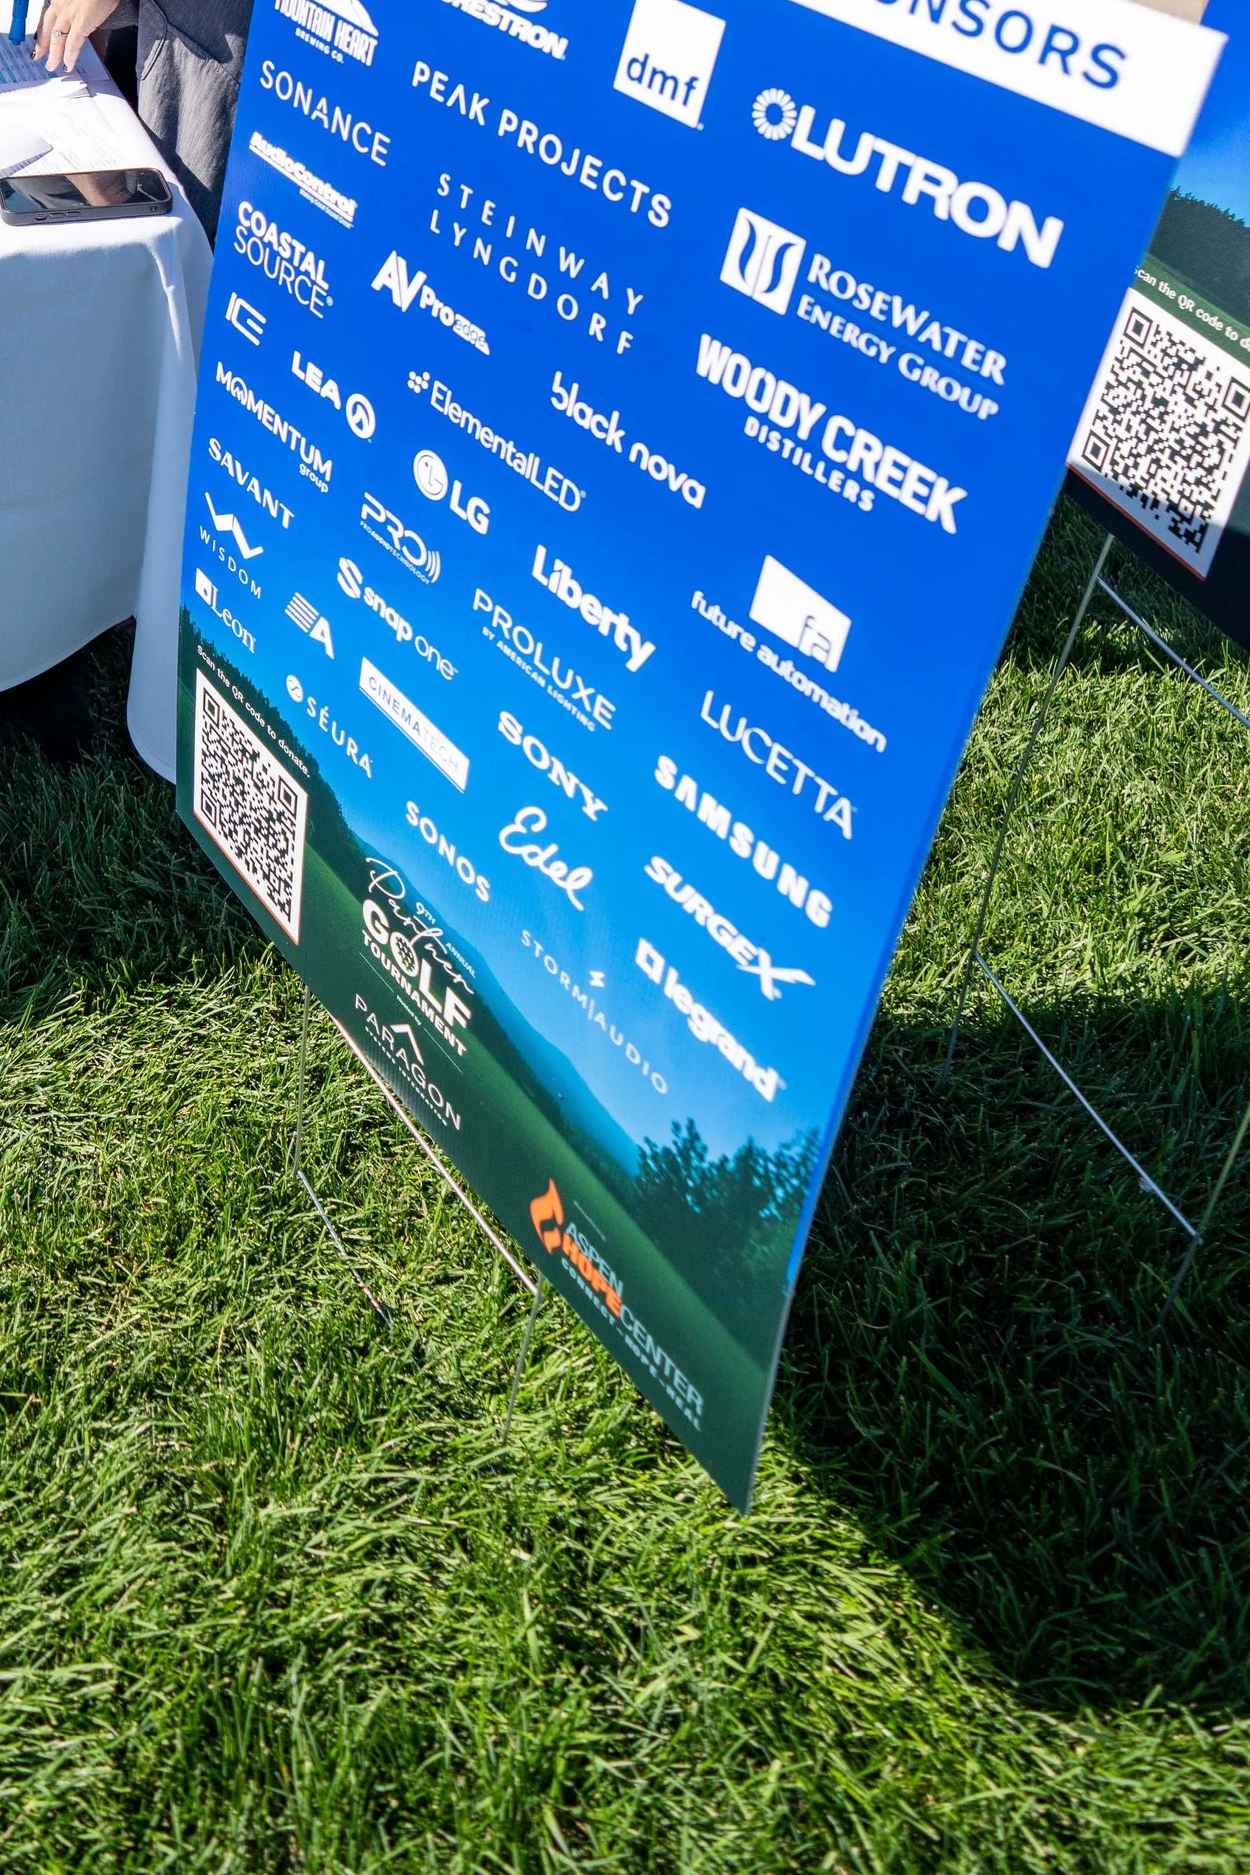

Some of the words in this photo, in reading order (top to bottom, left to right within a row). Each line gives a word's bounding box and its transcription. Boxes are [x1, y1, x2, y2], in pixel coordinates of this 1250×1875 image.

[295, 27, 330, 56] BREWING
[331, 50, 345, 63] CO.
[334, 18, 378, 67] HEART
[627, 53, 699, 107] dmf
[260, 60, 391, 167] SONANCE
[412, 61, 490, 126] PEAK
[498, 108, 672, 227] PROJECTS
[791, 104, 1064, 268] LUTRON
[238, 201, 330, 291] COASTAL
[430, 209, 634, 354] LYNGDORF
[437, 173, 643, 315] STEINWAY
[1158, 280, 1177, 300] the
[1177, 294, 1196, 313] QR
[1195, 308, 1224, 331] code
[1224, 325, 1239, 341] to
[216, 361, 332, 482] MOMENTUM
[291, 350, 341, 410] LEA
[208, 437, 295, 529] SAVANT
[299, 463, 329, 493] group
[550, 370, 626, 453] black
[629, 441, 706, 509] nova
[696, 333, 827, 441] WOODY
[821, 414, 968, 535] CREEK
[743, 415, 876, 512] DISTILLERS
[449, 480, 491, 535] LG
[199, 525, 262, 600] WISDOM
[532, 544, 656, 673] Liberty
[210, 584, 256, 654] Leon
[363, 586, 414, 642] snap
[414, 635, 456, 681] one
[472, 588, 616, 731] PROLUXE
[691, 590, 757, 652] future
[756, 644, 887, 753] automation
[197, 645, 216, 671] Scan
[217, 668, 230, 688] the
[231, 685, 244, 703] QR
[245, 702, 266, 727] code
[267, 725, 277, 740] to
[278, 738, 311, 778] donate.
[482, 626, 495, 641] BY
[496, 639, 546, 688] AMERICAN
[547, 684, 596, 732] LIGHTING
[306, 696, 372, 779] SÉURA
[498, 710, 608, 822] SONY
[700, 690, 853, 840] LUCETTA
[406, 800, 490, 902] SONOS
[499, 806, 594, 912] Edel
[654, 755, 833, 928] SAMSUNG
[362, 899, 472, 1029] GOLF
[365, 857, 475, 995] Partner
[415, 901, 436, 925] 9TH
[446, 942, 476, 978] ANNUAL
[361, 929, 467, 1057] TOURNAMENT
[663, 967, 780, 1102] legrand
[355, 993, 462, 1131] PARAGON
[566, 1222, 624, 1299] ASPEN
